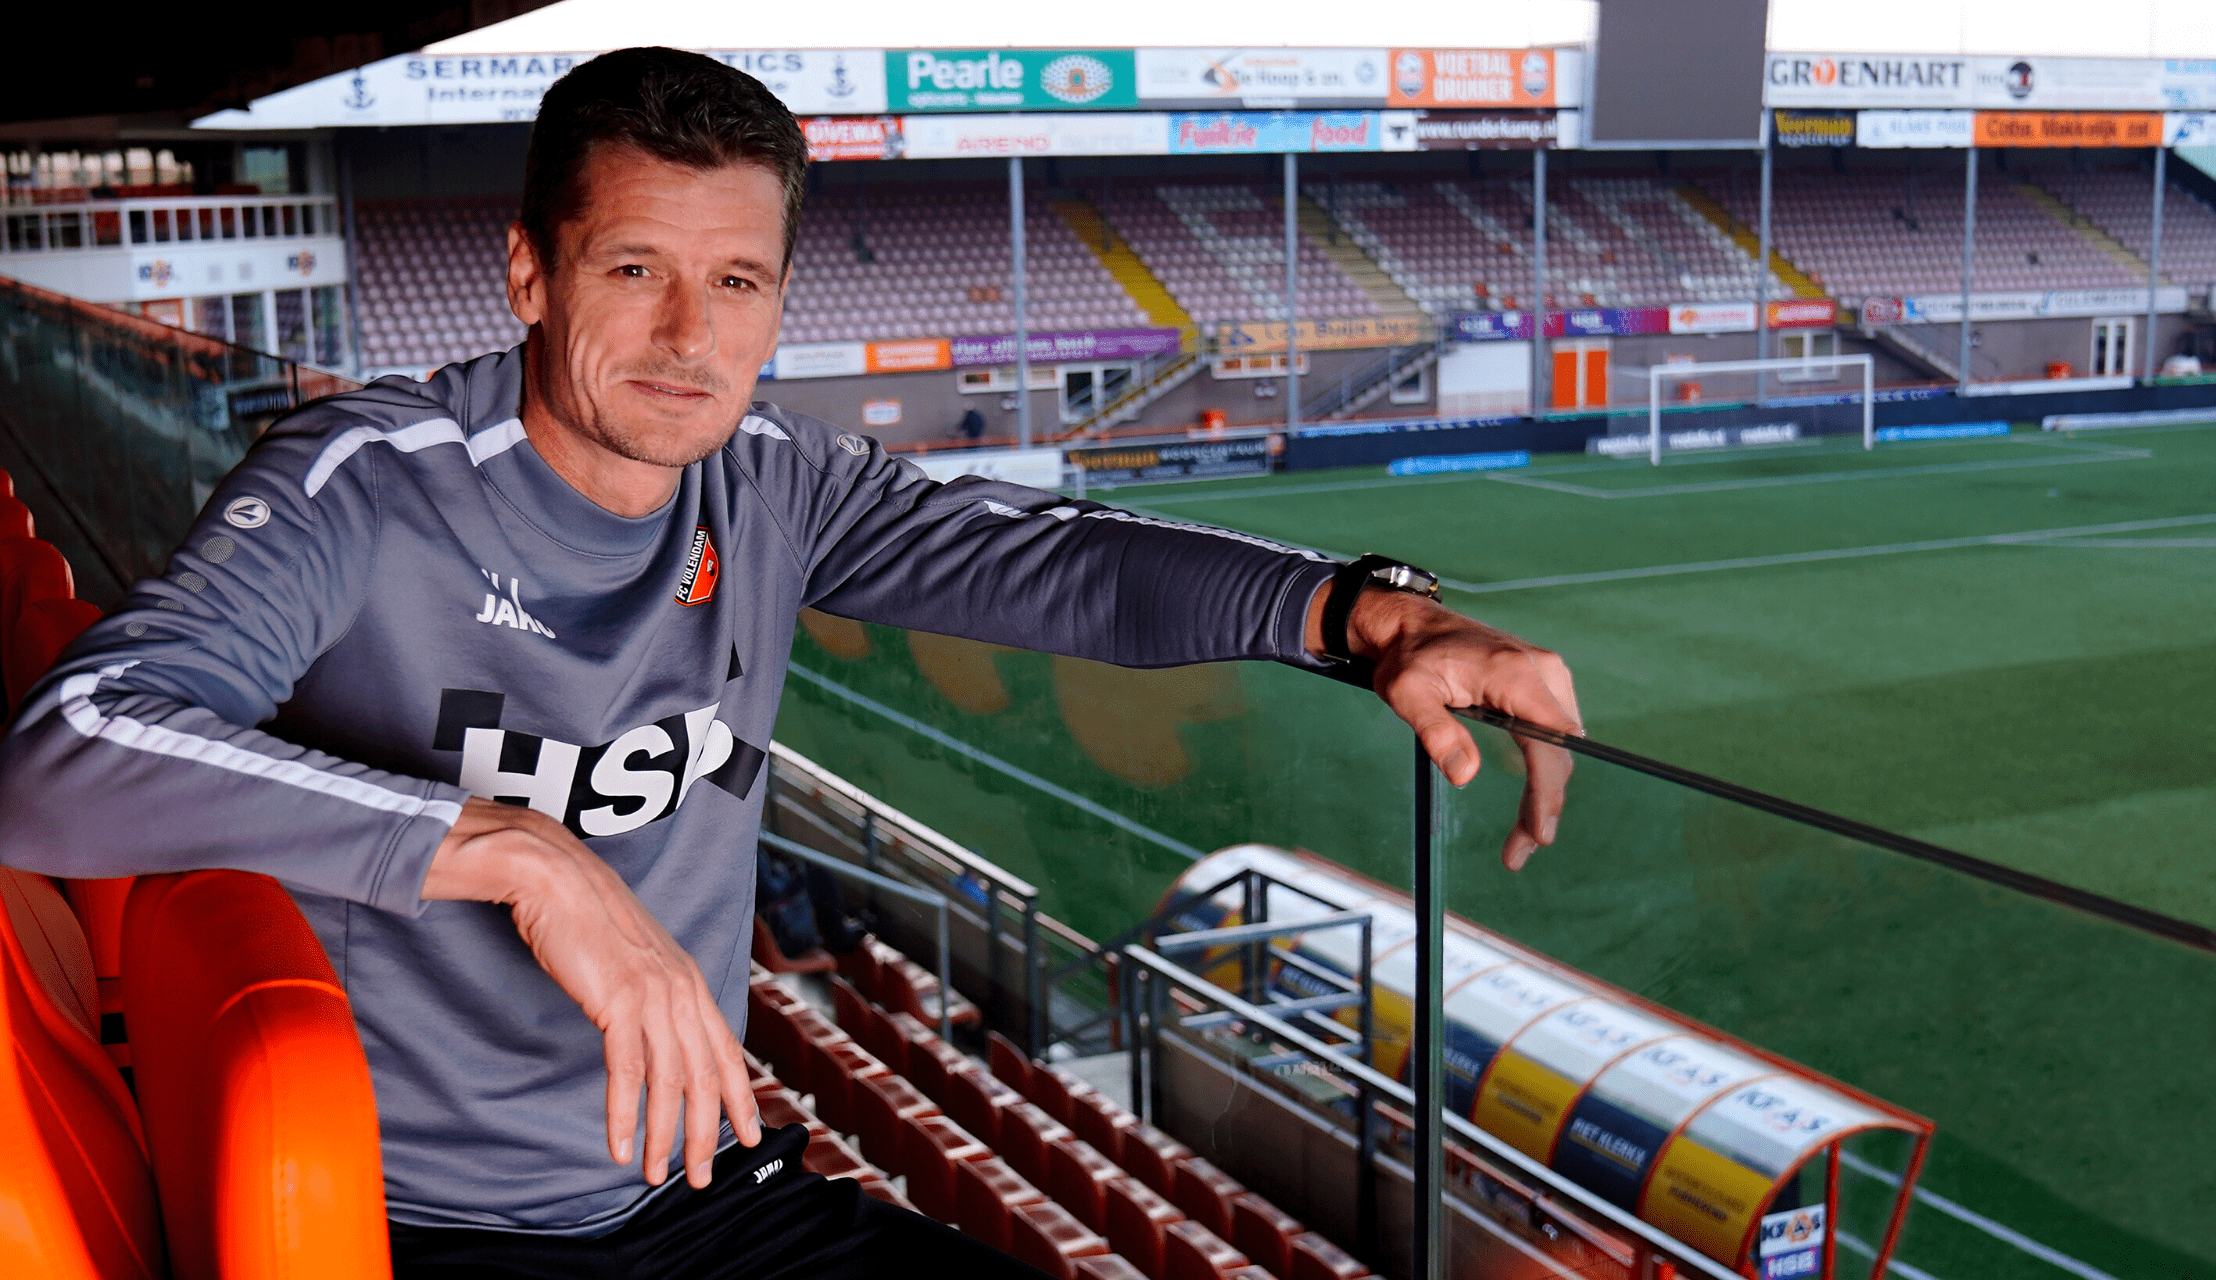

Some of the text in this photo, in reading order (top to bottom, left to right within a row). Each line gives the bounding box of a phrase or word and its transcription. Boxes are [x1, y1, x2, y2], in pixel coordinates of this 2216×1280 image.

[719, 53, 803, 73] TICS
[907, 52, 1024, 89] Pearle
[1771, 58, 1965, 87] GROENHART
[676, 530, 706, 600] FC VOLENDAM
[1768, 1250, 1815, 1278] HSB
